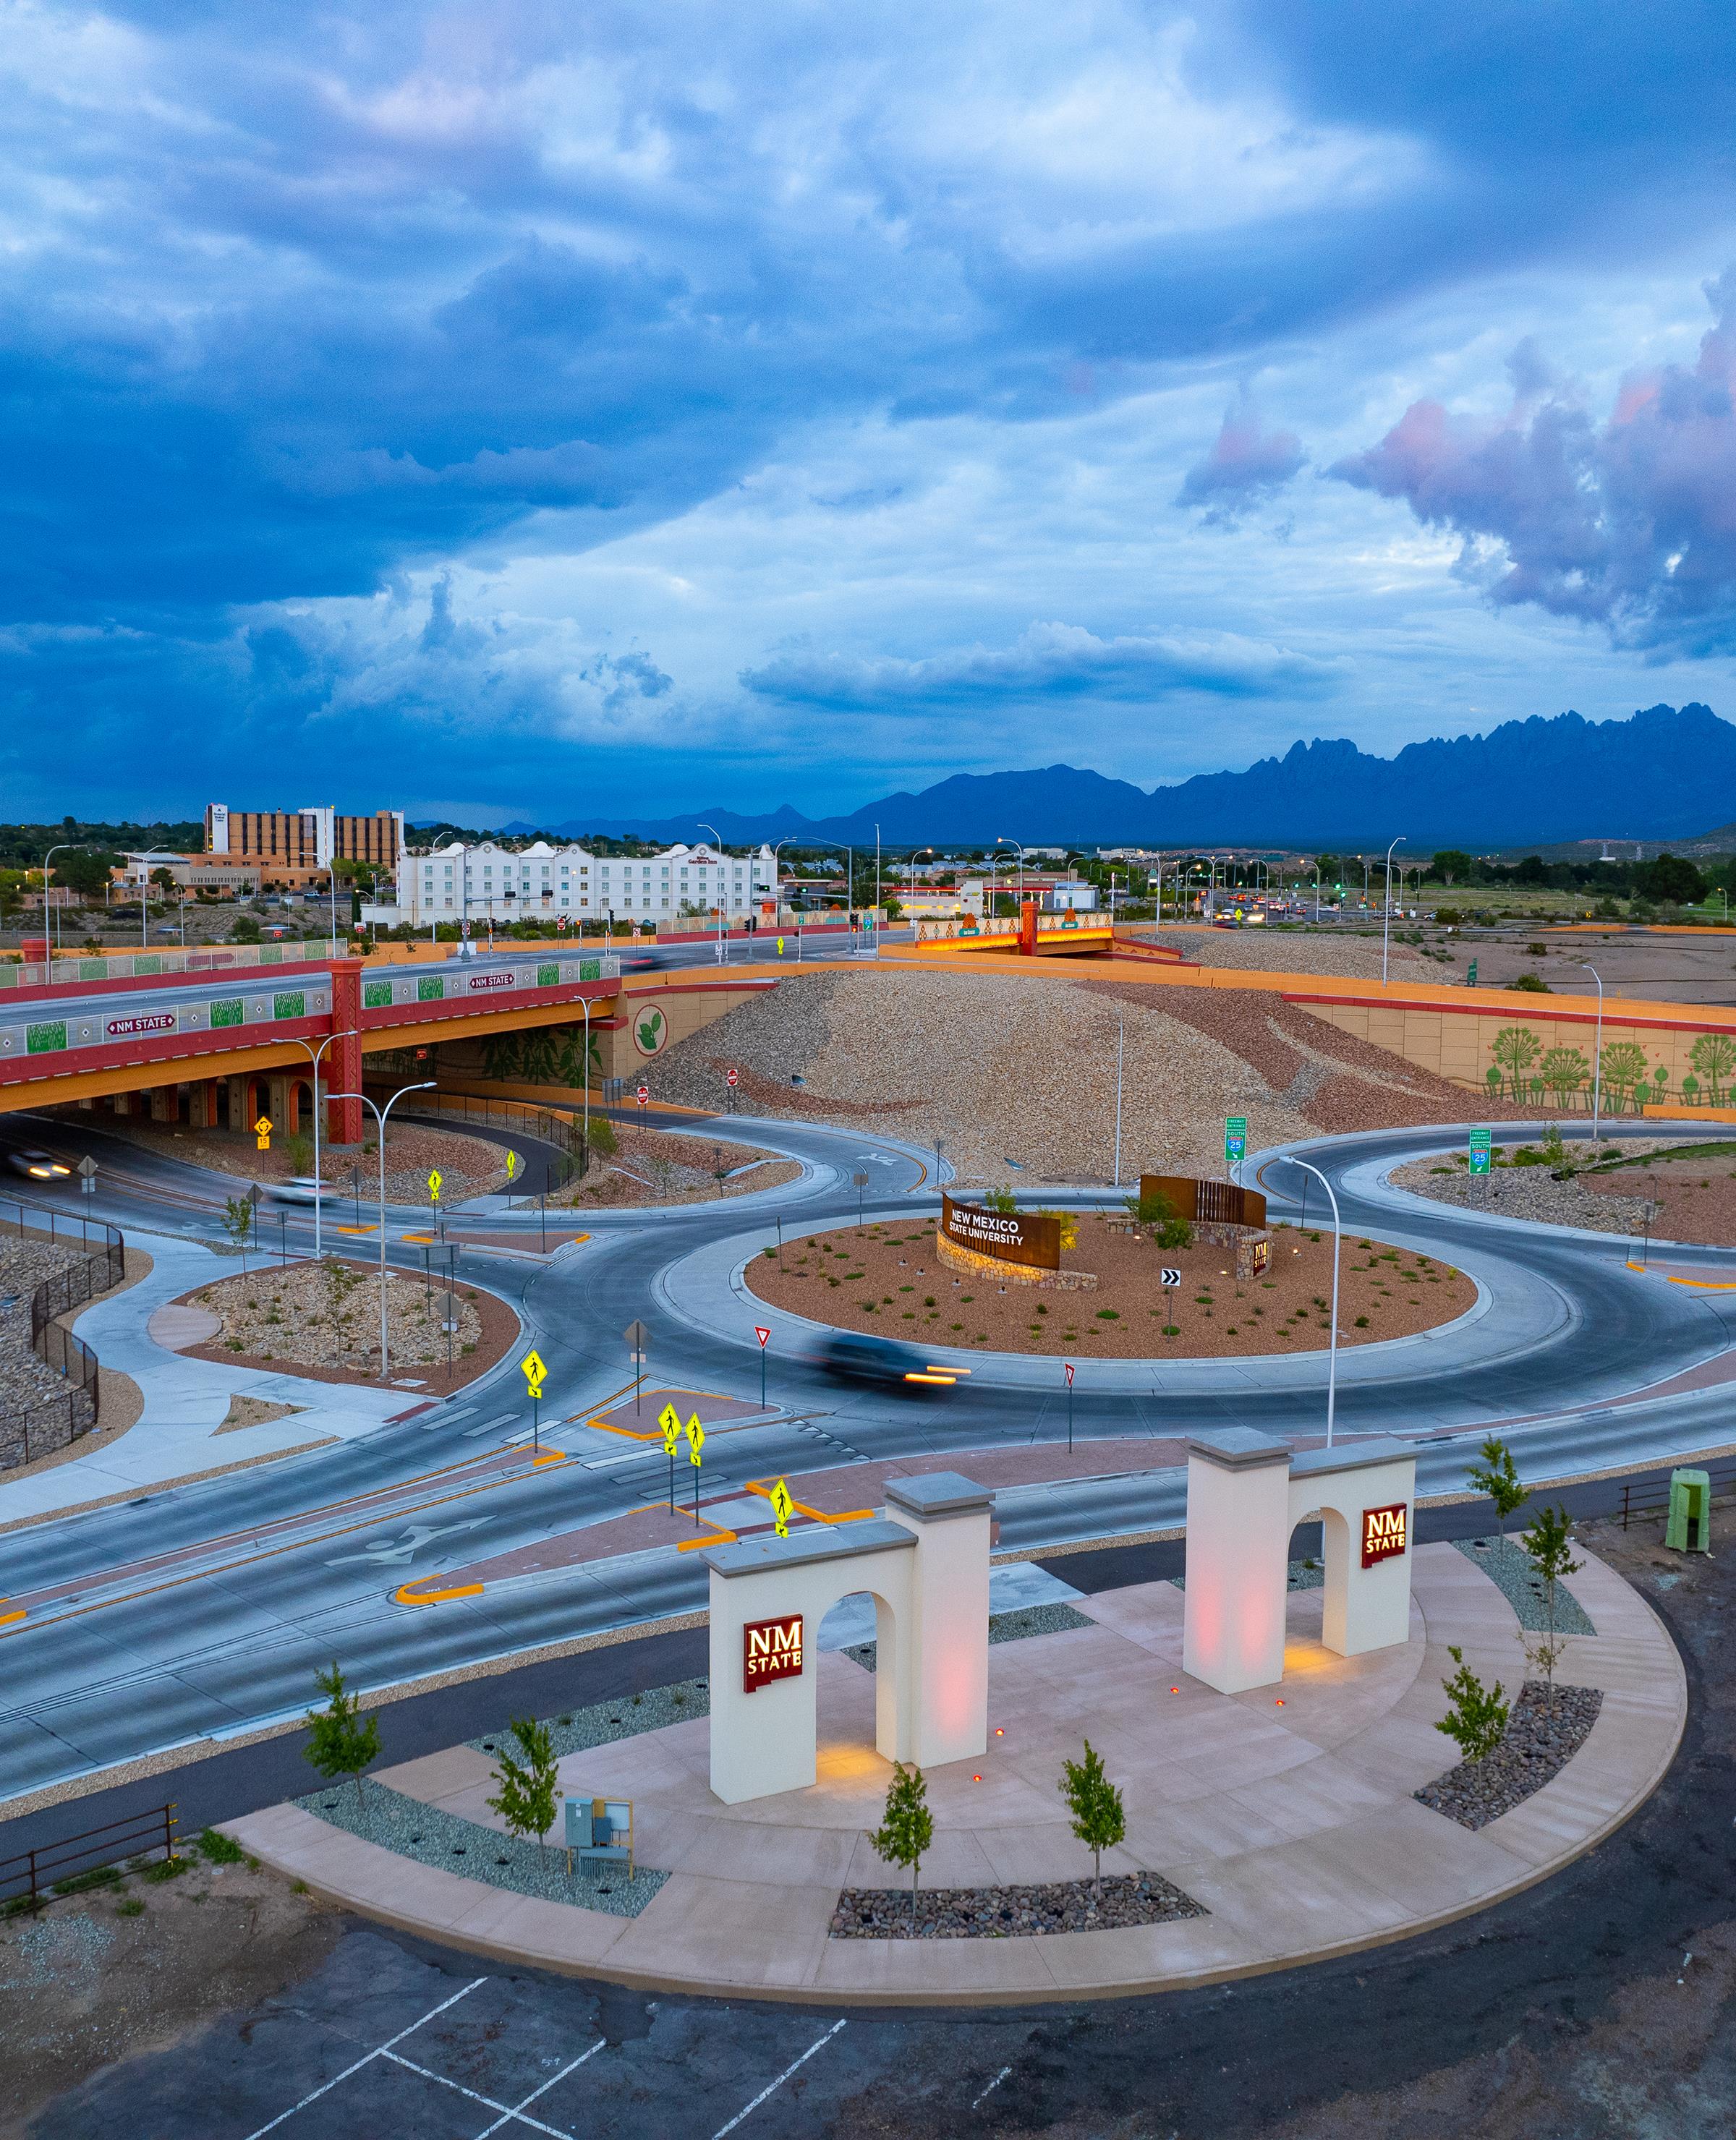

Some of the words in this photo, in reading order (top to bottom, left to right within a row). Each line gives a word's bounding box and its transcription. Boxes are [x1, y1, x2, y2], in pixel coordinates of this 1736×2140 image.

[476, 979, 487, 987] NM
[488, 976, 509, 986] STATE
[116, 1020, 133, 1033] NM
[135, 1017, 166, 1030] STATE
[952, 1209, 970, 1224] NEW
[973, 1215, 1018, 1233] MEXICO
[950, 1222, 967, 1235] STATE
[969, 1227, 1024, 1245] UNIVERSITY
[1255, 1242, 1267, 1259] NM
[1254, 1256, 1266, 1268] STATE
[1366, 1509, 1405, 1539] NM
[1366, 1533, 1405, 1553] STATE
[748, 1621, 801, 1658] NM
[748, 1650, 801, 1674] STATE
